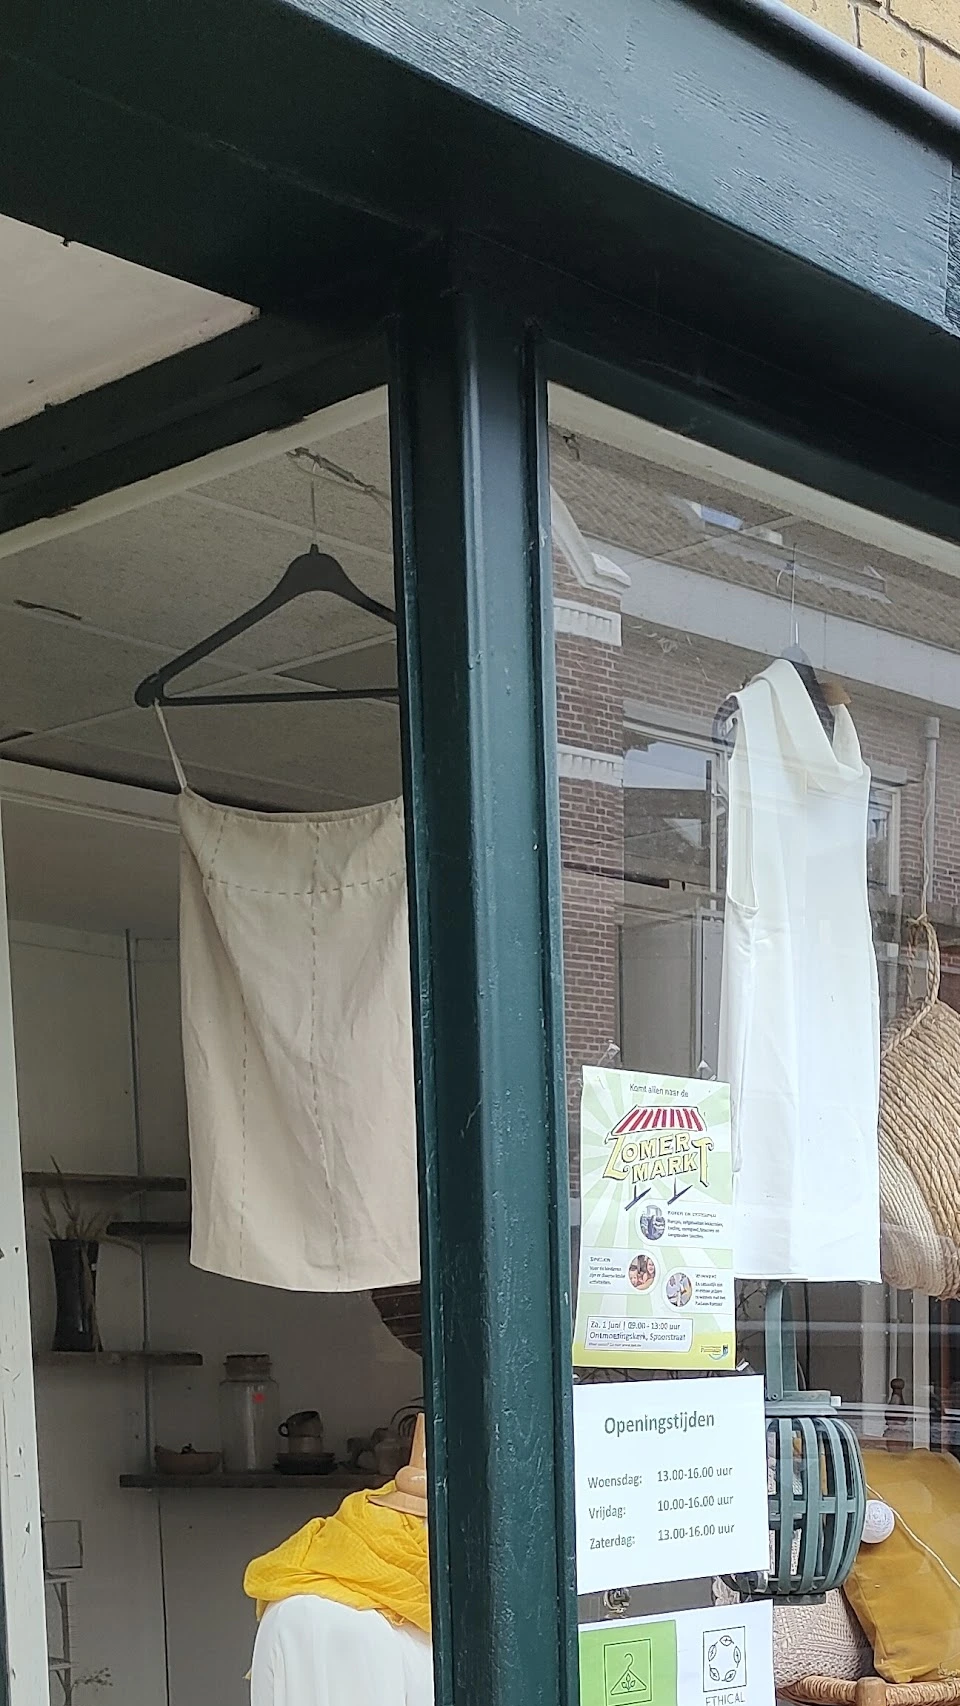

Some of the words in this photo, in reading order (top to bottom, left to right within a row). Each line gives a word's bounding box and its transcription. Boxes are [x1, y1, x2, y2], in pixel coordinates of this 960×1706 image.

[602, 1131, 691, 1181] ZOMER
[632, 1137, 715, 1187] MARKT
[649, 1332, 686, 1342] Spoorstraat
[604, 1411, 715, 1438] Openingstijden
[587, 1473, 643, 1489] Woensdag:
[657, 1466, 714, 1482] 13.00-16.00
[716, 1466, 733, 1477] uur
[588, 1505, 626, 1521] Vrijdag:
[657, 1495, 715, 1512] 10.00-16.00
[717, 1495, 734, 1506] uur
[589, 1534, 636, 1550] Zaterdag:
[657, 1524, 715, 1541] 13.00-16.00
[717, 1523, 735, 1535] uur
